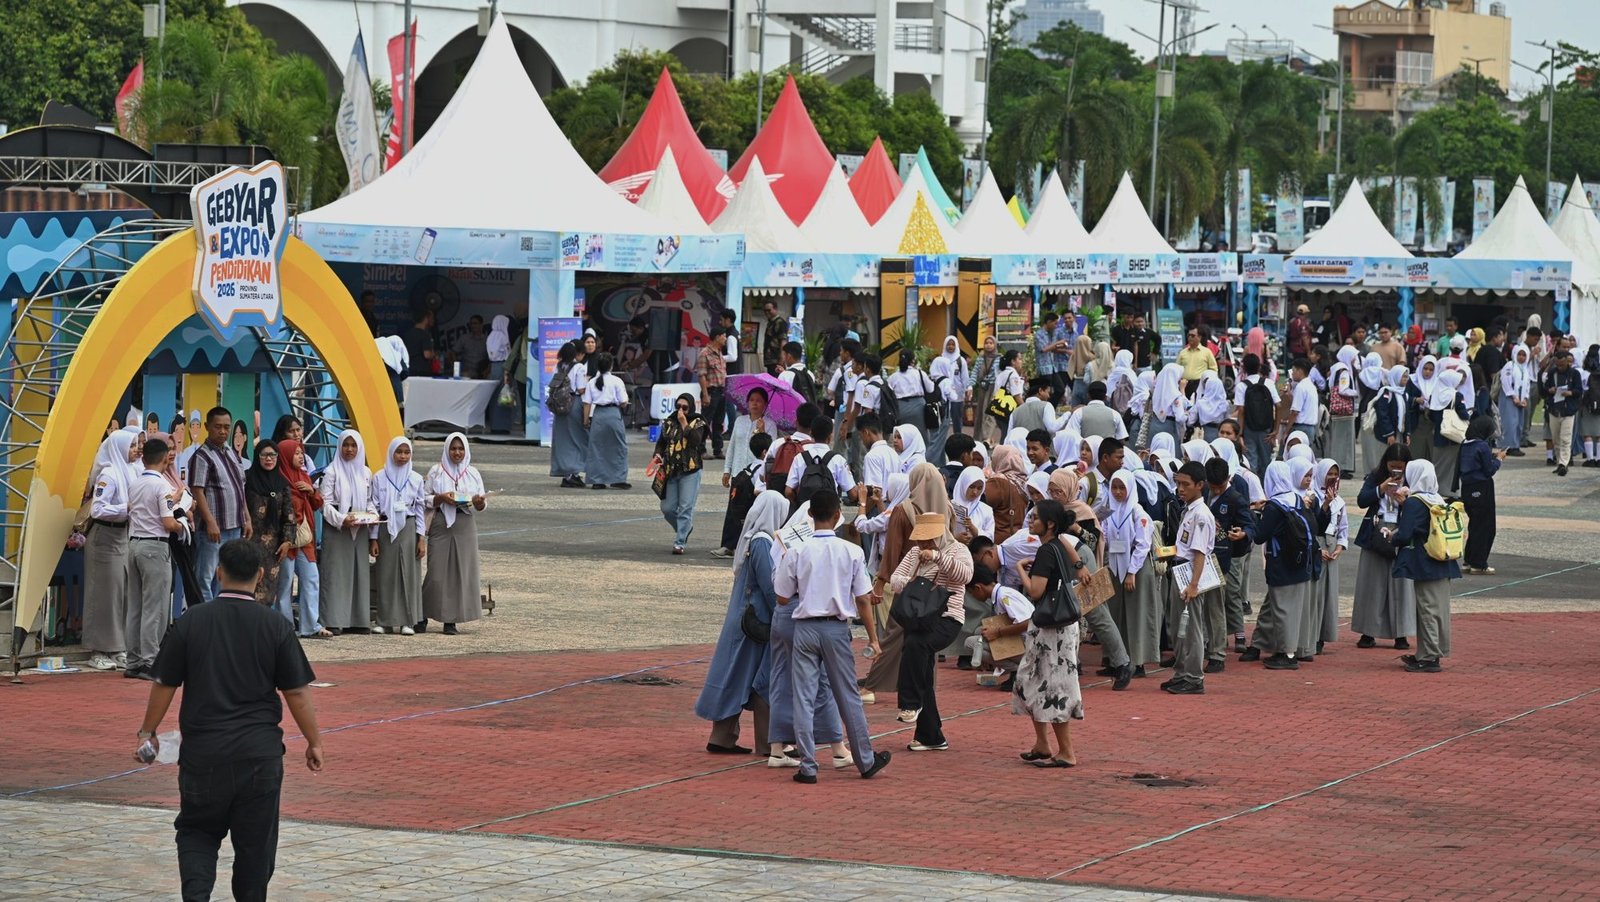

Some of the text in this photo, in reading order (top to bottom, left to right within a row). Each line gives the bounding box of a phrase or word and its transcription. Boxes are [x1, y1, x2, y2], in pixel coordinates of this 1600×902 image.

[207, 177, 277, 241] GEBYAR
[211, 226, 260, 259] & EXPO
[1056, 258, 1075, 269] Honda
[1076, 258, 1085, 269] EV
[1129, 259, 1150, 271] SHEP
[1060, 272, 1073, 281] Safety
[1074, 272, 1087, 281] Riding
[217, 282, 236, 298] 2026
[239, 285, 258, 293] PROVINSI
[239, 292, 260, 300] SUMATERA
